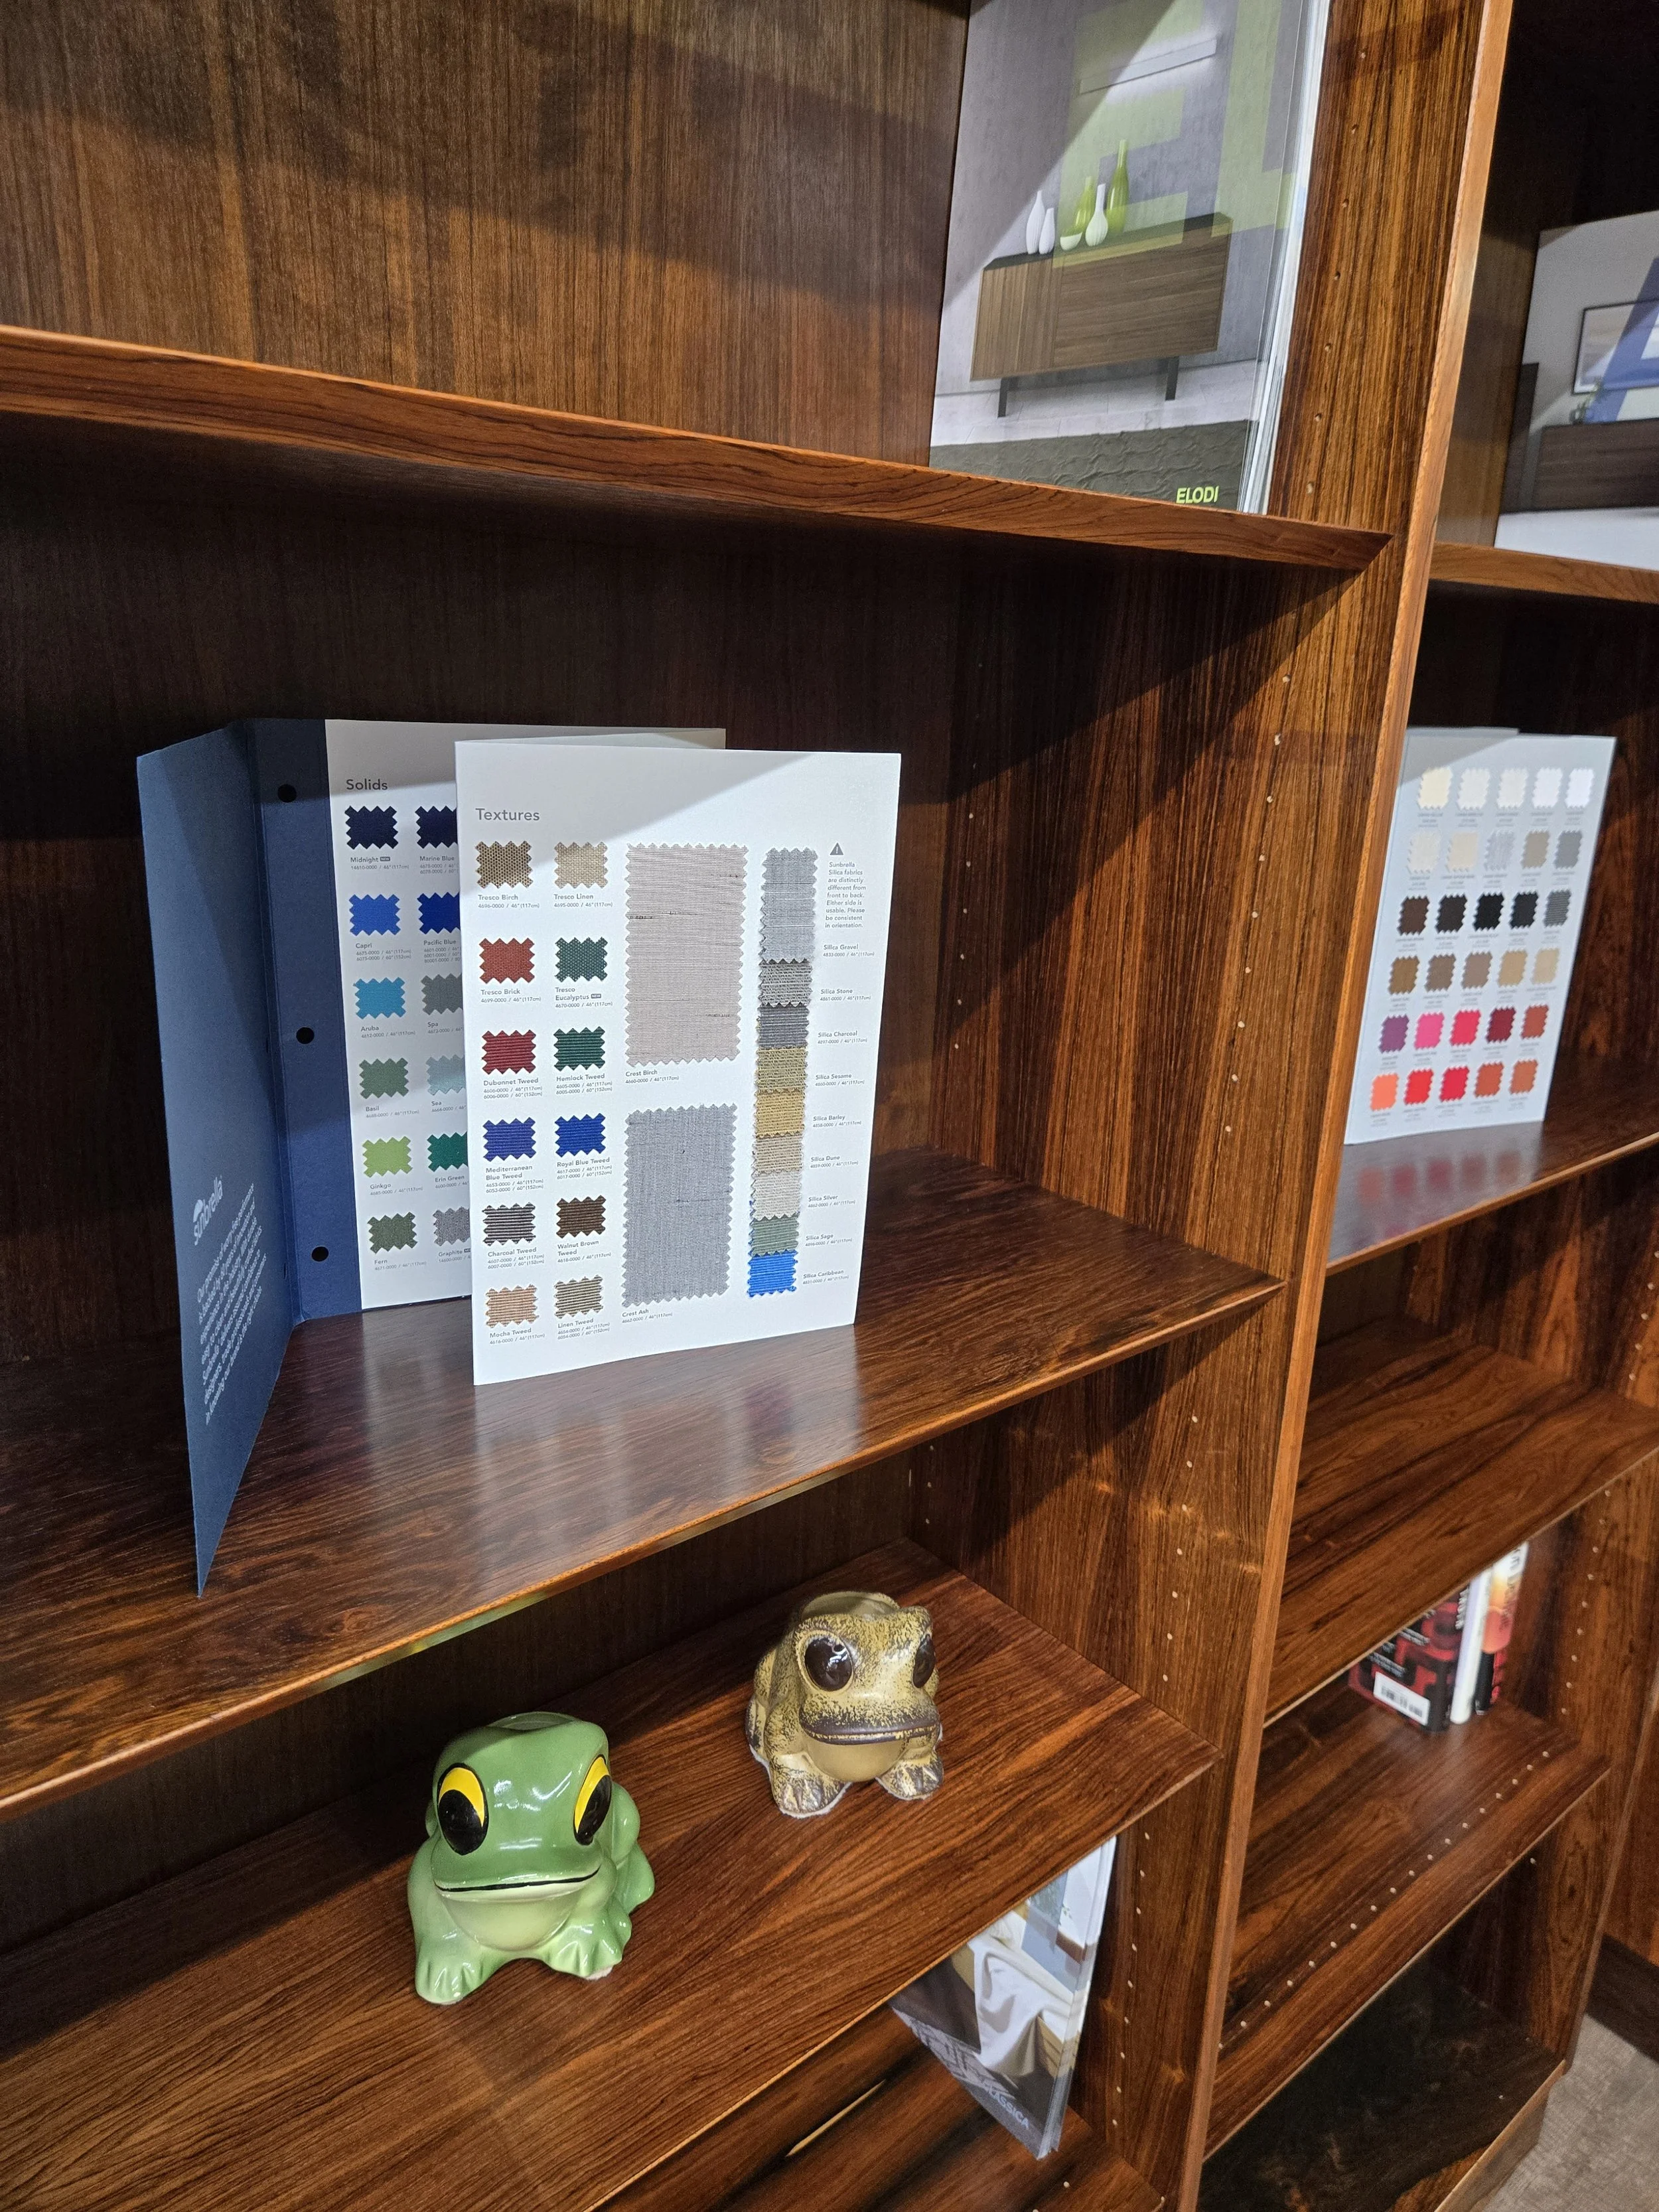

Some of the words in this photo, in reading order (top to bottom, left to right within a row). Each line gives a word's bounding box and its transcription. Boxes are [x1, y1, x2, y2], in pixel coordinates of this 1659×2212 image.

[1176, 485, 1220, 504] ELODI
[346, 778, 388, 791] Solids
[475, 808, 541, 821] Textures
[193, 1177, 223, 1246] sunbrella
